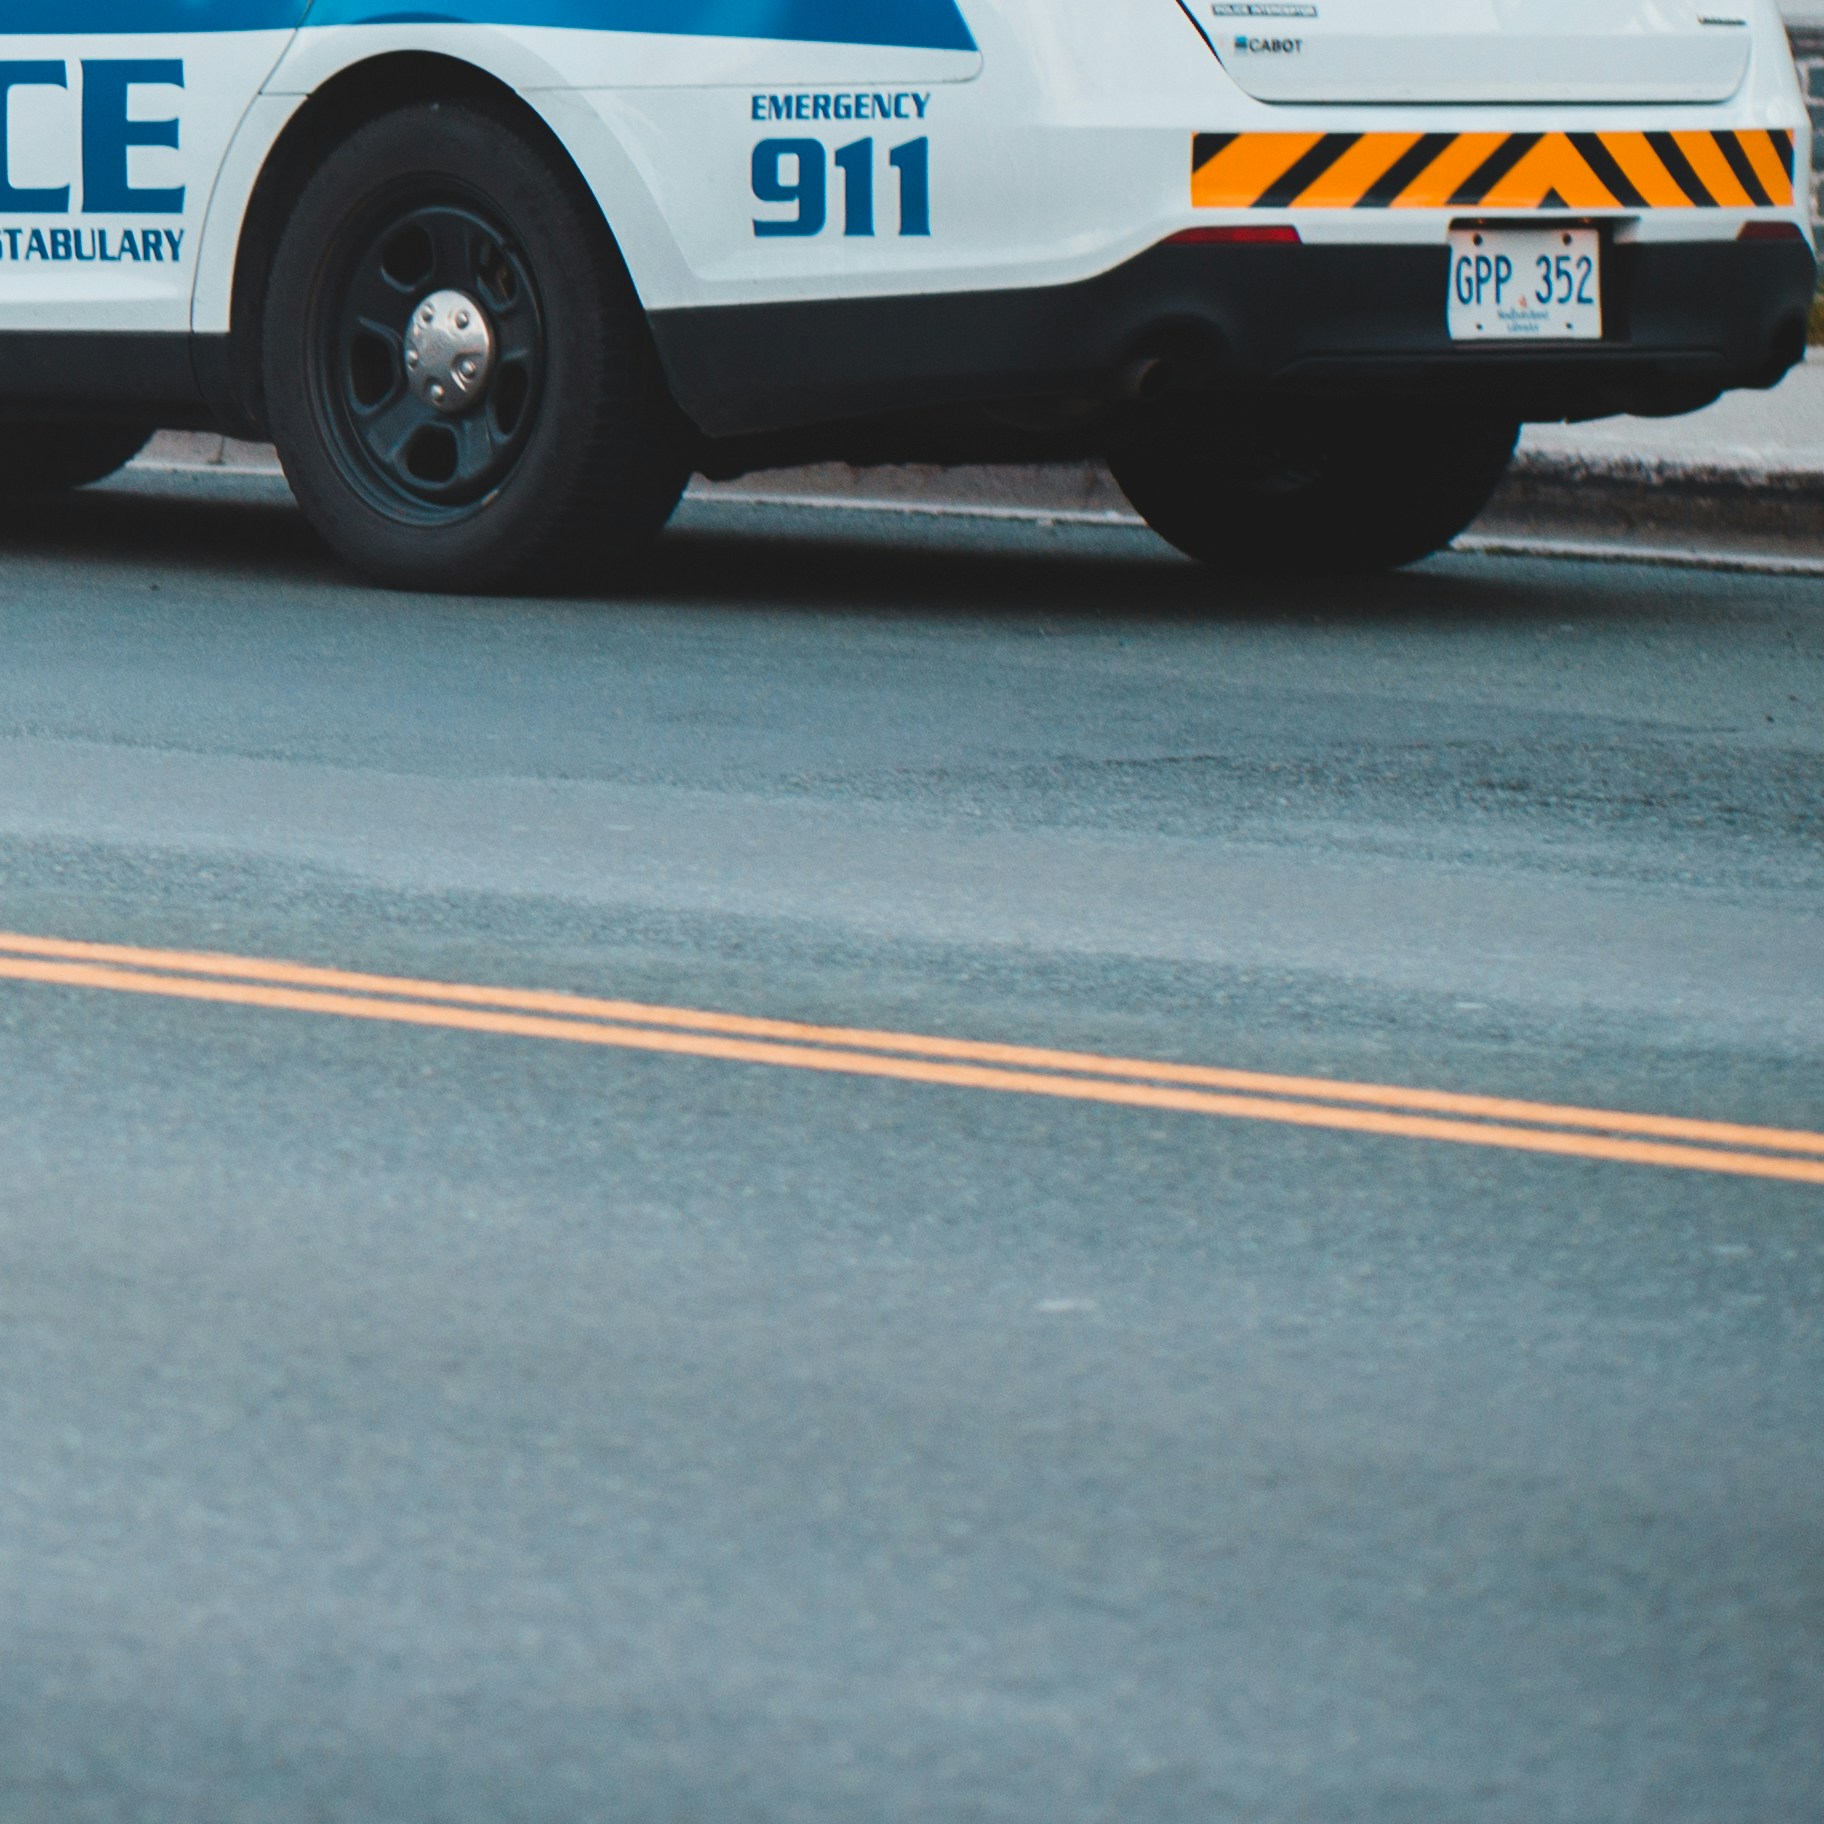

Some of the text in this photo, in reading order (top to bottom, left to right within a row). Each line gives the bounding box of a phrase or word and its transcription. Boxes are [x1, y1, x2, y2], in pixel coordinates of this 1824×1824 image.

[1249, 38, 1303, 53] CABOT
[751, 91, 931, 120] EMERGENCY
[751, 136, 931, 237] 911
[1456, 255, 1594, 305] GPP 352
